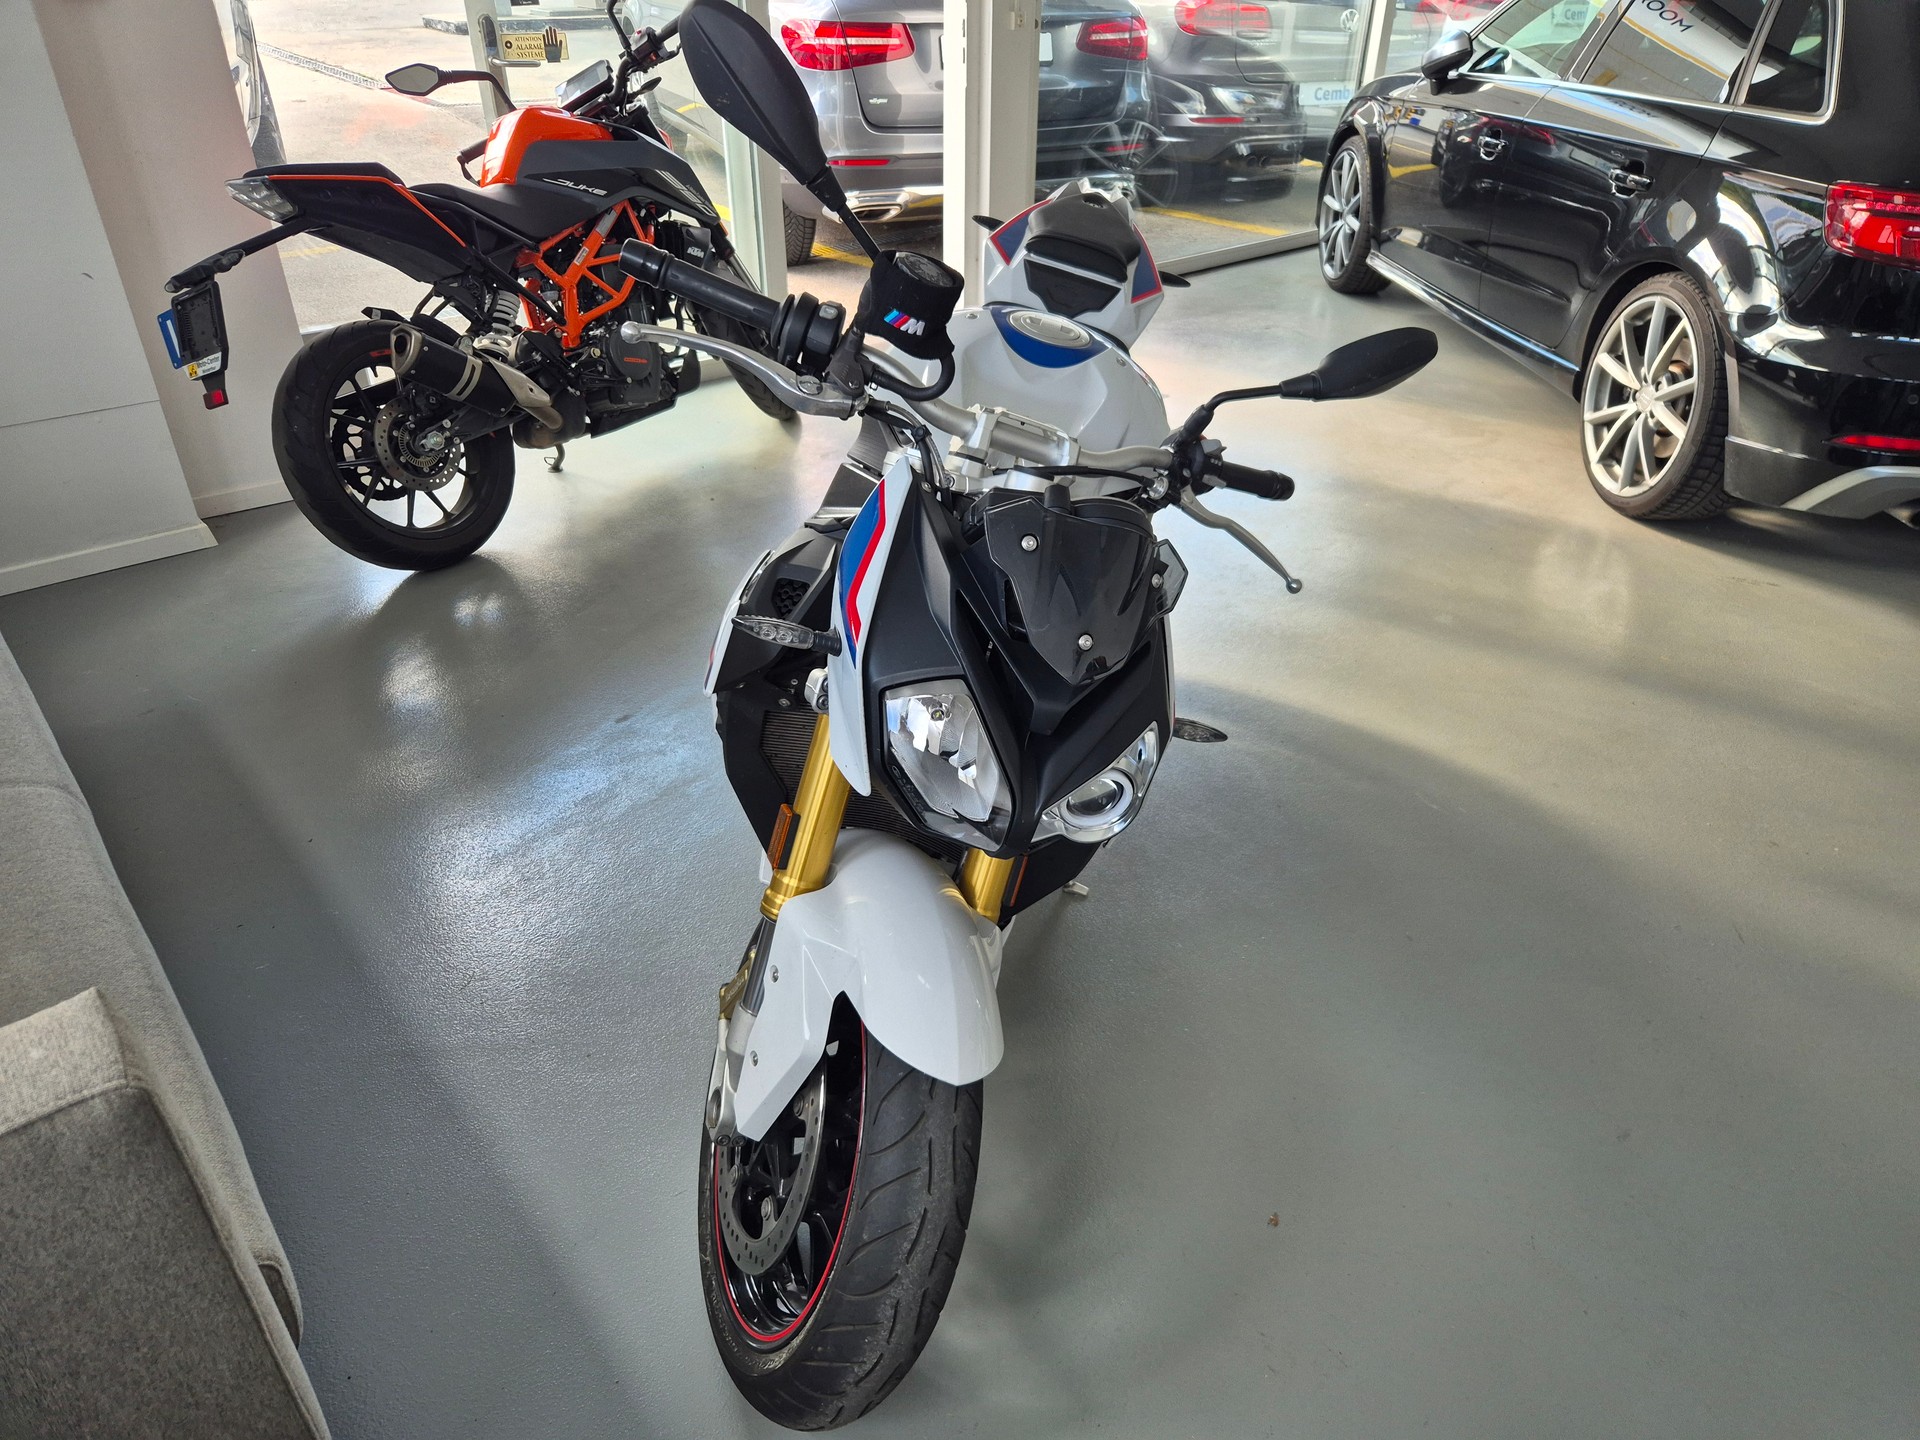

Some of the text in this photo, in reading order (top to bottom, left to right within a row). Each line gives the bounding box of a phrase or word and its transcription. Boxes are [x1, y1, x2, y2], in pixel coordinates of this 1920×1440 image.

[1641, 0, 1694, 32] OOM
[542, 178, 608, 196] DUKE
[686, 246, 705, 259] KTM
